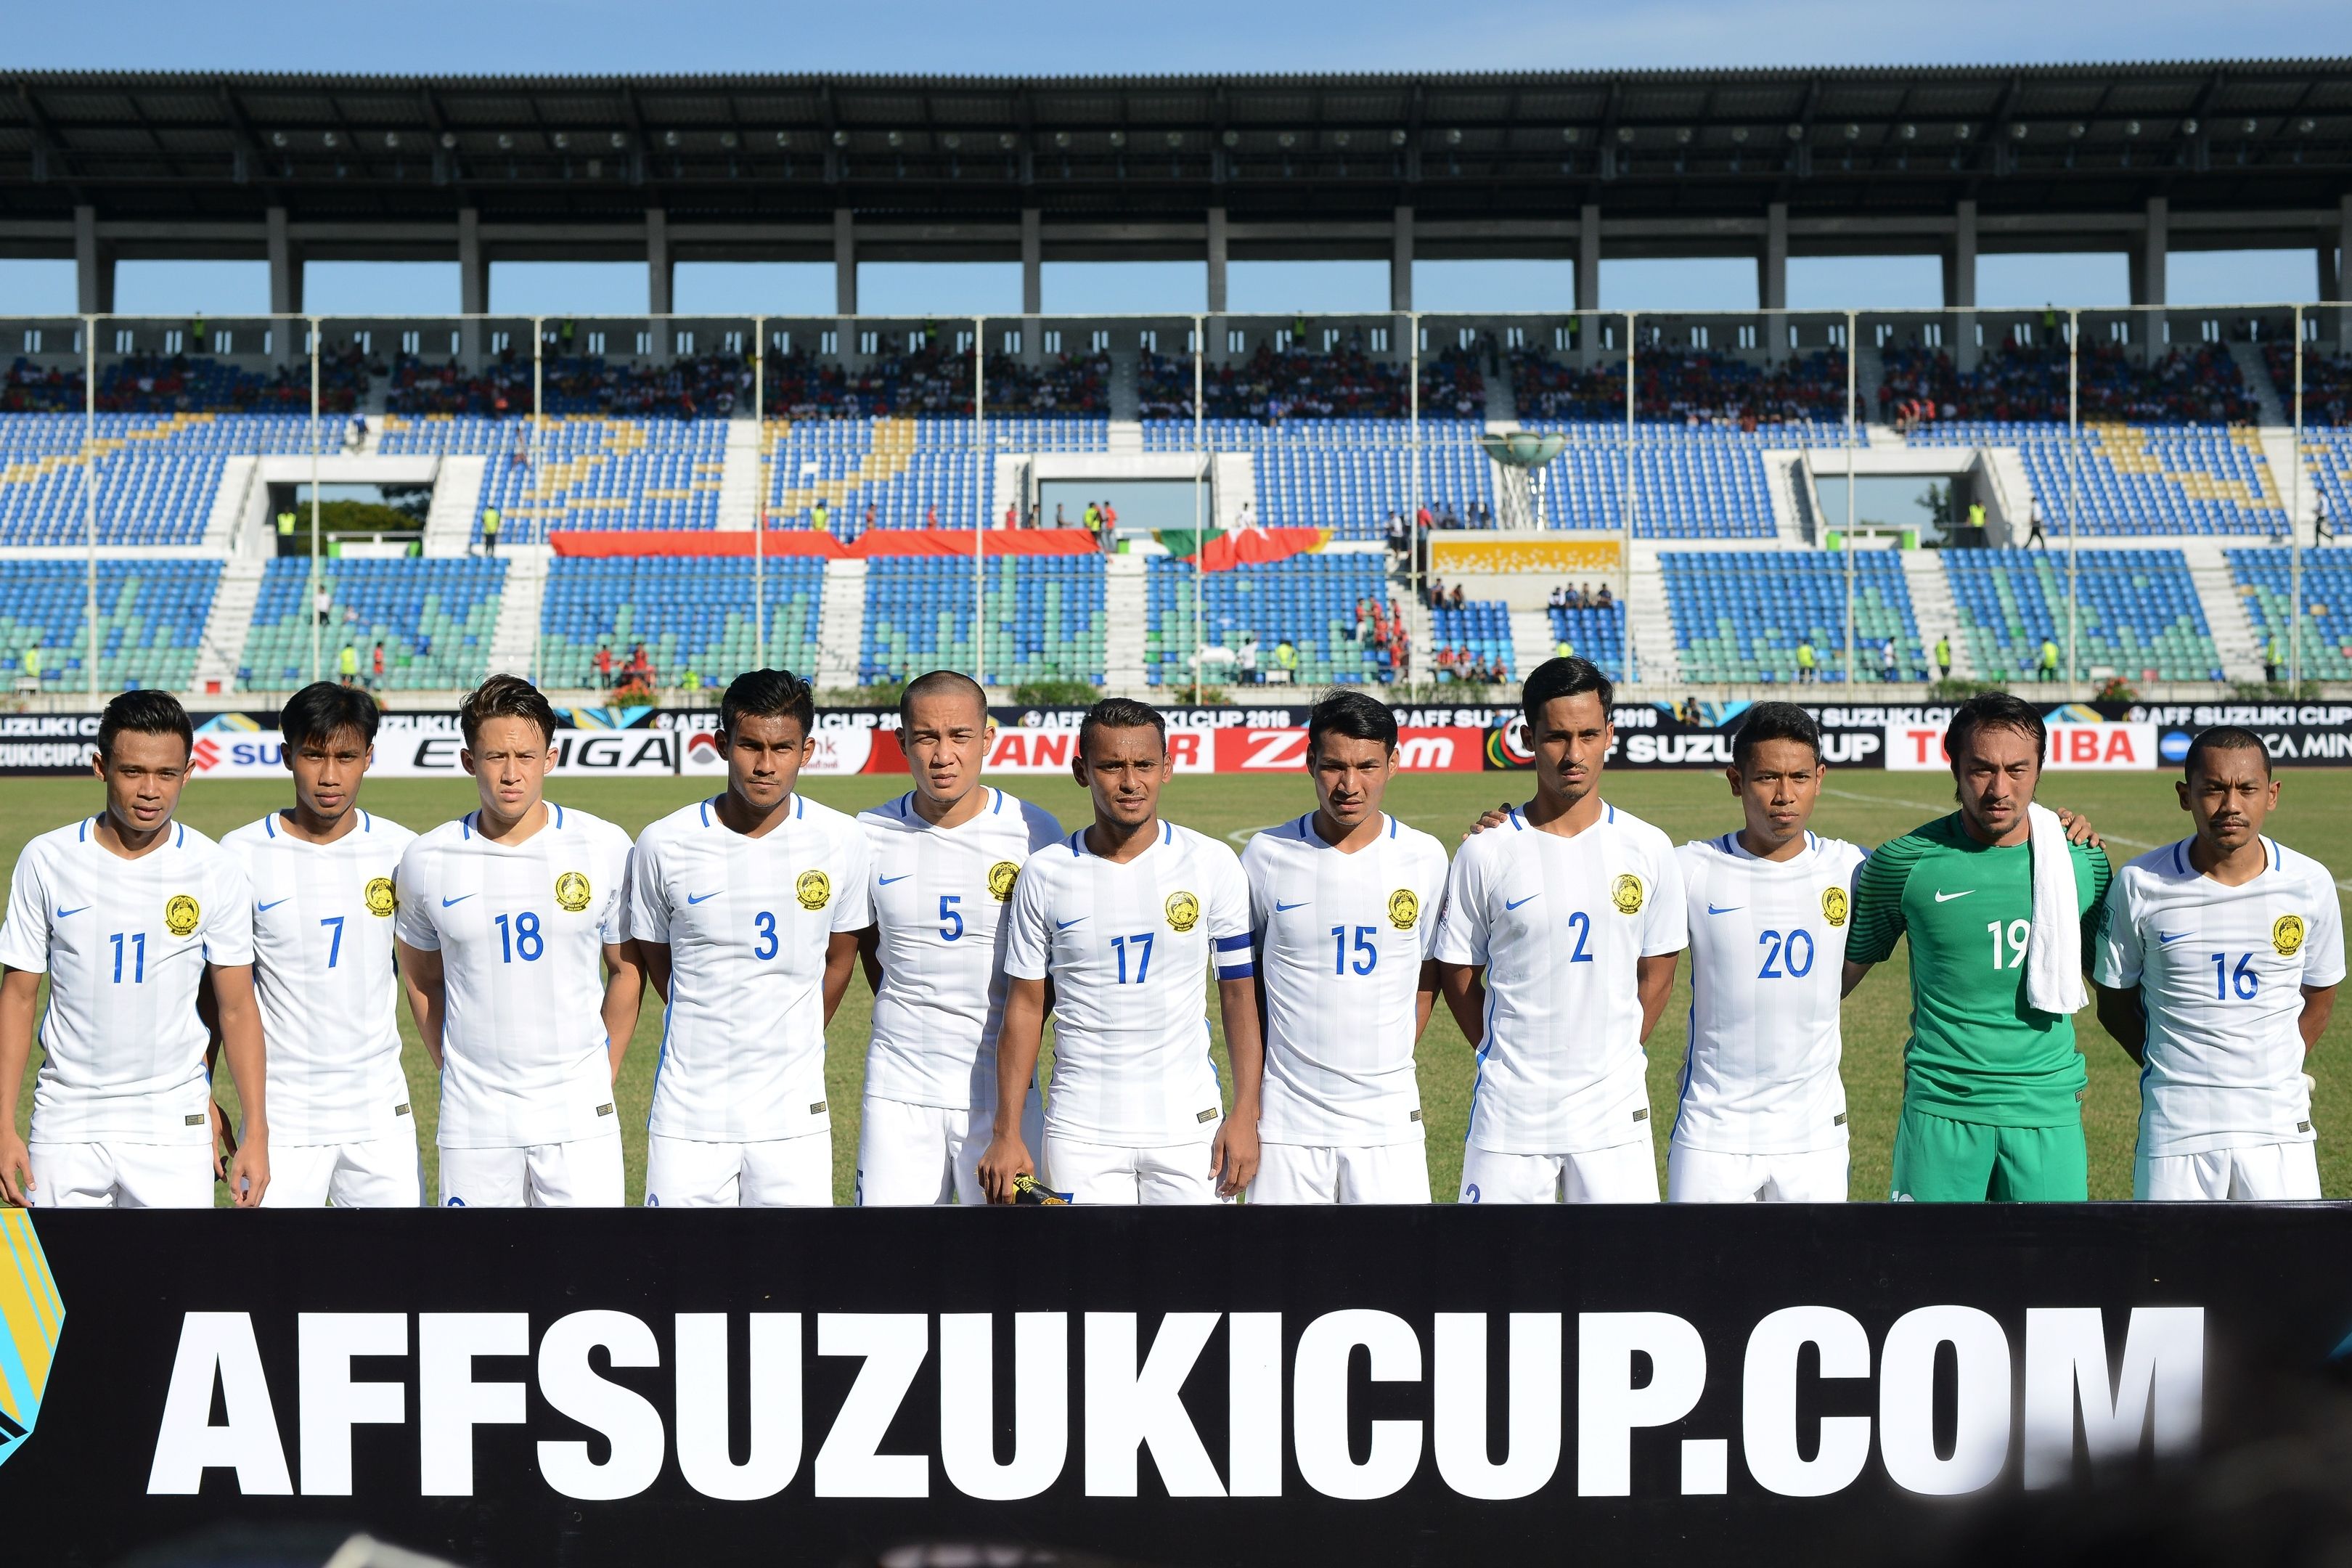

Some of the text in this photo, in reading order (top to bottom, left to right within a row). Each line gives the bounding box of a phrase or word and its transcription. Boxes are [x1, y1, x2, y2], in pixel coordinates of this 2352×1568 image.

[1189, 711, 1244, 729] CUP
[1246, 710, 1290, 729] 2016
[1408, 710, 1453, 728] AFF
[1612, 709, 1657, 728] 2016
[1821, 707, 1923, 727] SUZUKI
[2147, 706, 2352, 726] AFF SUZUKI CUP
[414, 738, 672, 767] EIGA
[1626, 734, 1736, 763] SUZU
[1821, 732, 1880, 762] UP
[1907, 730, 2136, 763] TIBA
[321, 916, 344, 968] 7
[495, 912, 544, 963] 18
[754, 911, 779, 960] 3
[940, 896, 963, 942] 5
[1568, 911, 1593, 963] 2
[110, 933, 145, 984] 11
[1111, 932, 1154, 984] 17
[1331, 926, 1377, 976] 15
[1757, 928, 1814, 979] 20
[1987, 918, 2031, 970] 19
[2211, 952, 2258, 1000] 16
[147, 1304, 2205, 1501] AFFSUZUKICUP.COM
